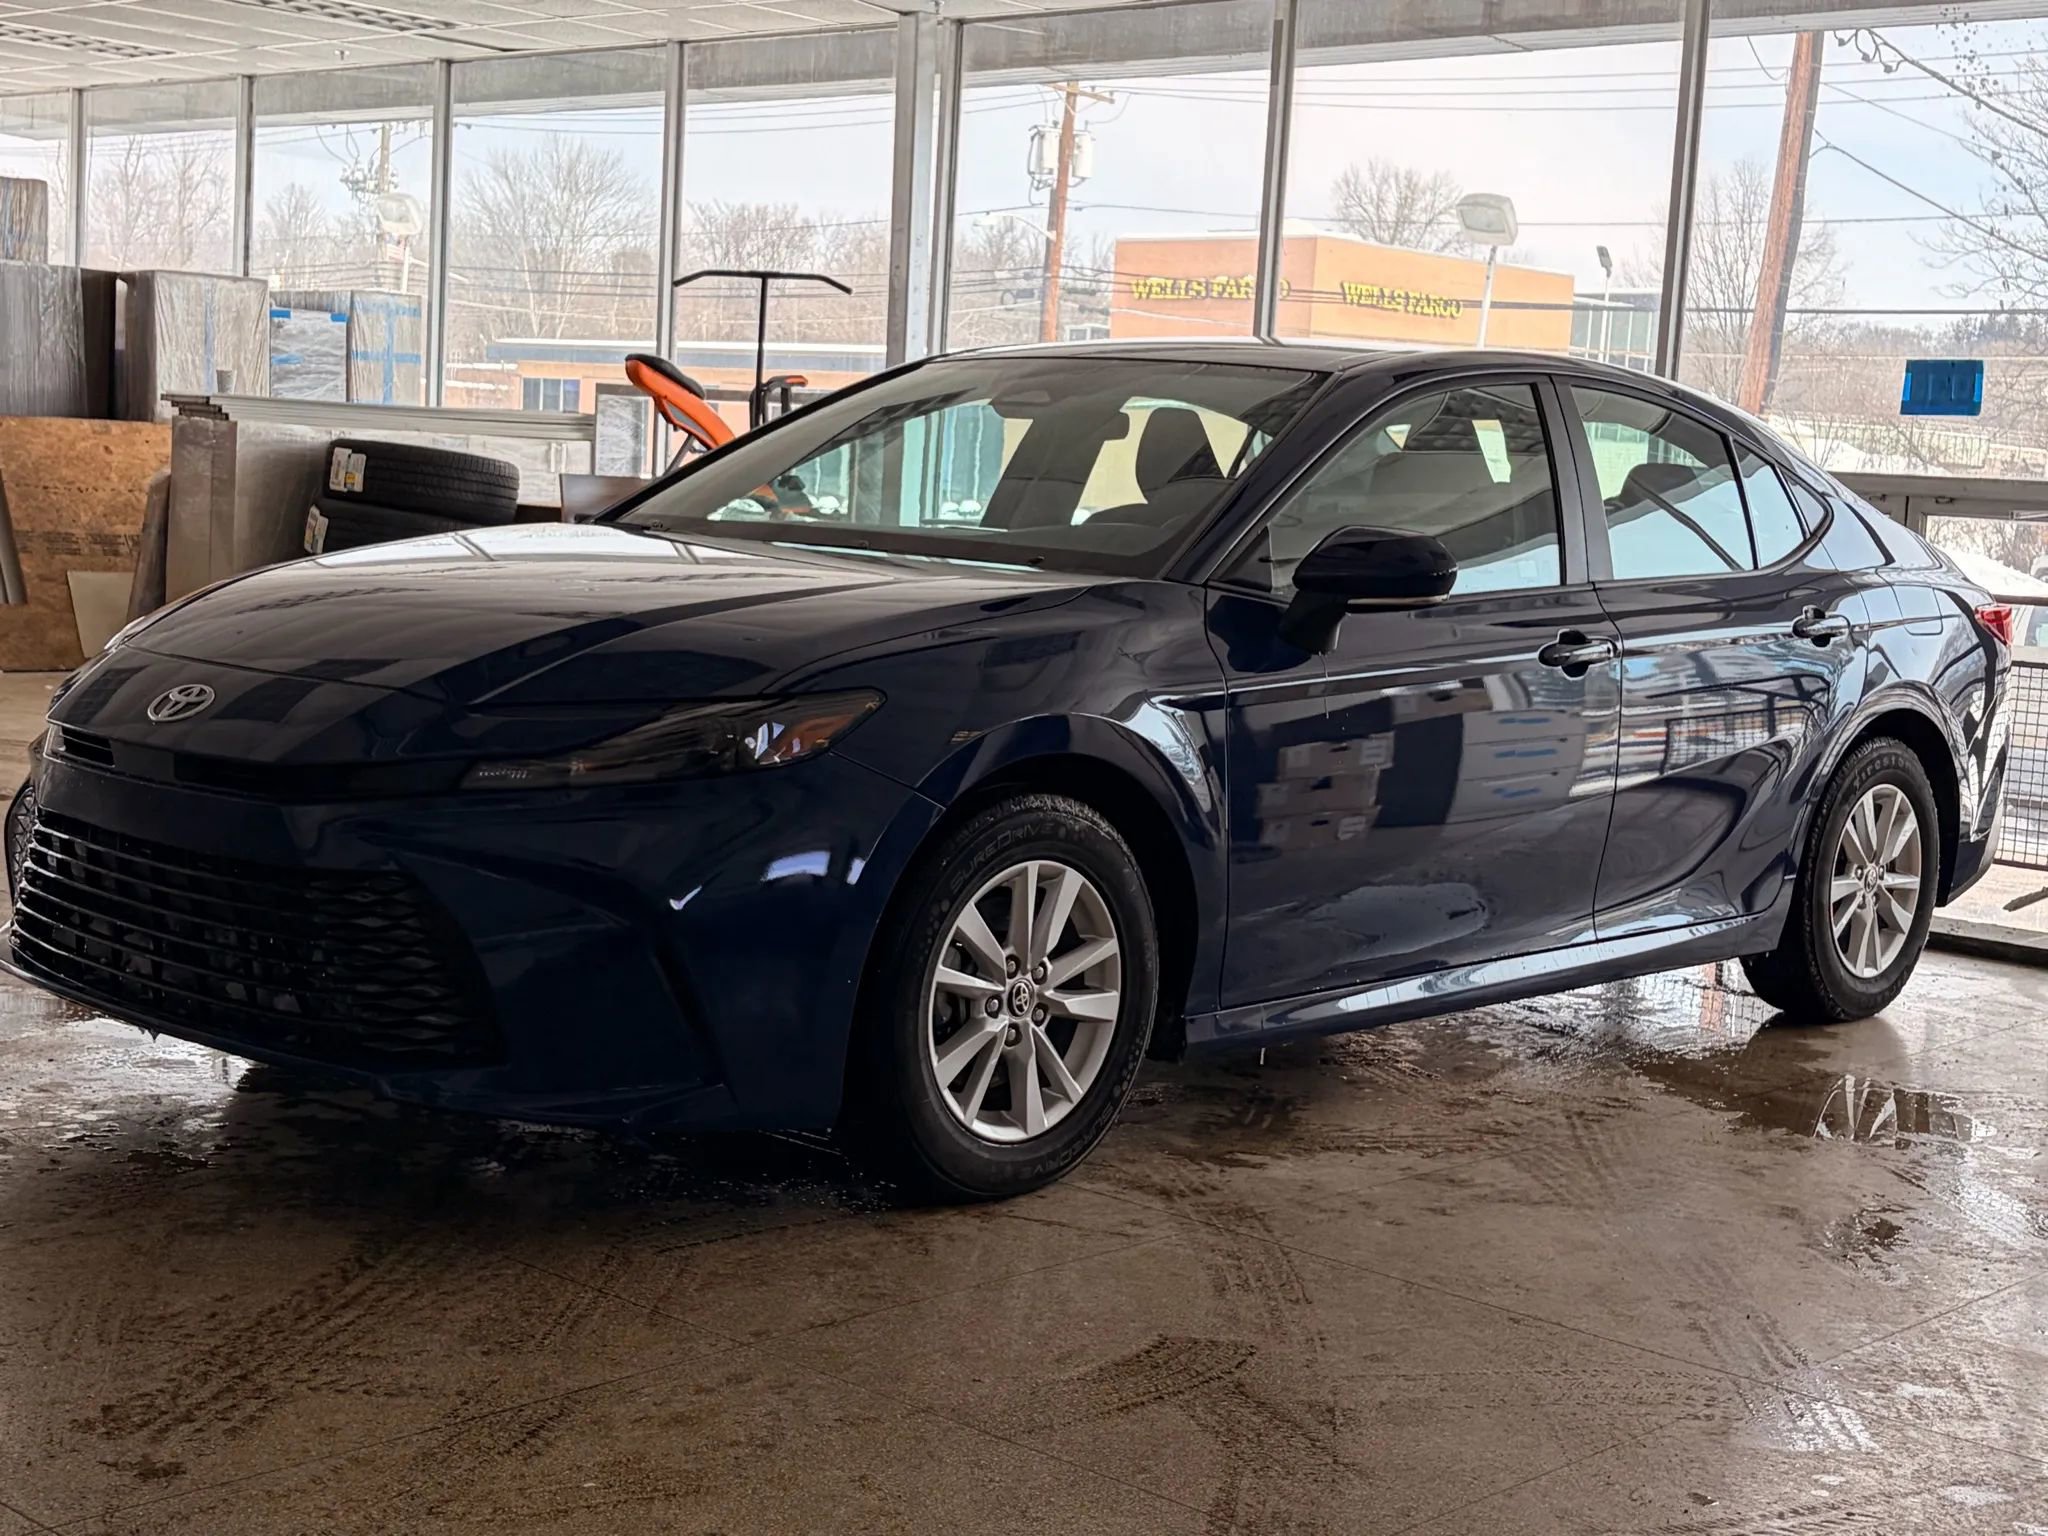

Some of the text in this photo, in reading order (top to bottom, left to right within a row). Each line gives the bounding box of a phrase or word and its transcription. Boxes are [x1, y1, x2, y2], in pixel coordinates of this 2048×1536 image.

[1131, 275, 1292, 300] WELLS FARO
[1340, 281, 1405, 312] WELLS
